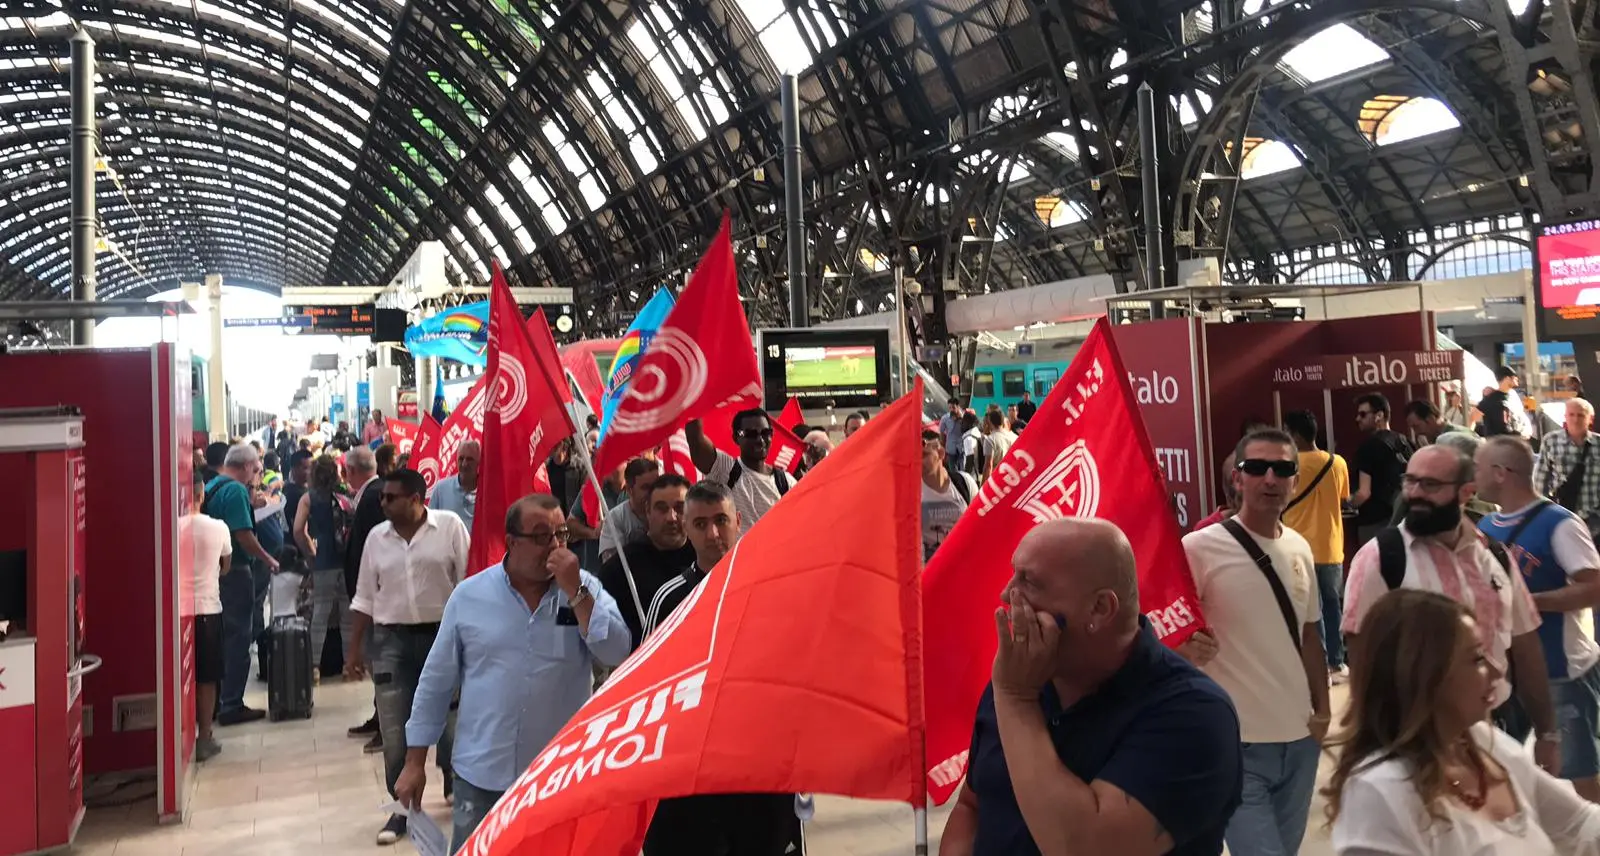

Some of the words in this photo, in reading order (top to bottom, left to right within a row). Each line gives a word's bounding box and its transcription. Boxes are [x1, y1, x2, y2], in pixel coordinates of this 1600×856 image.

[767, 344, 780, 358] 15
[1415, 352, 1453, 366] BIGLIETTI
[1419, 367, 1452, 382] TICKETS
